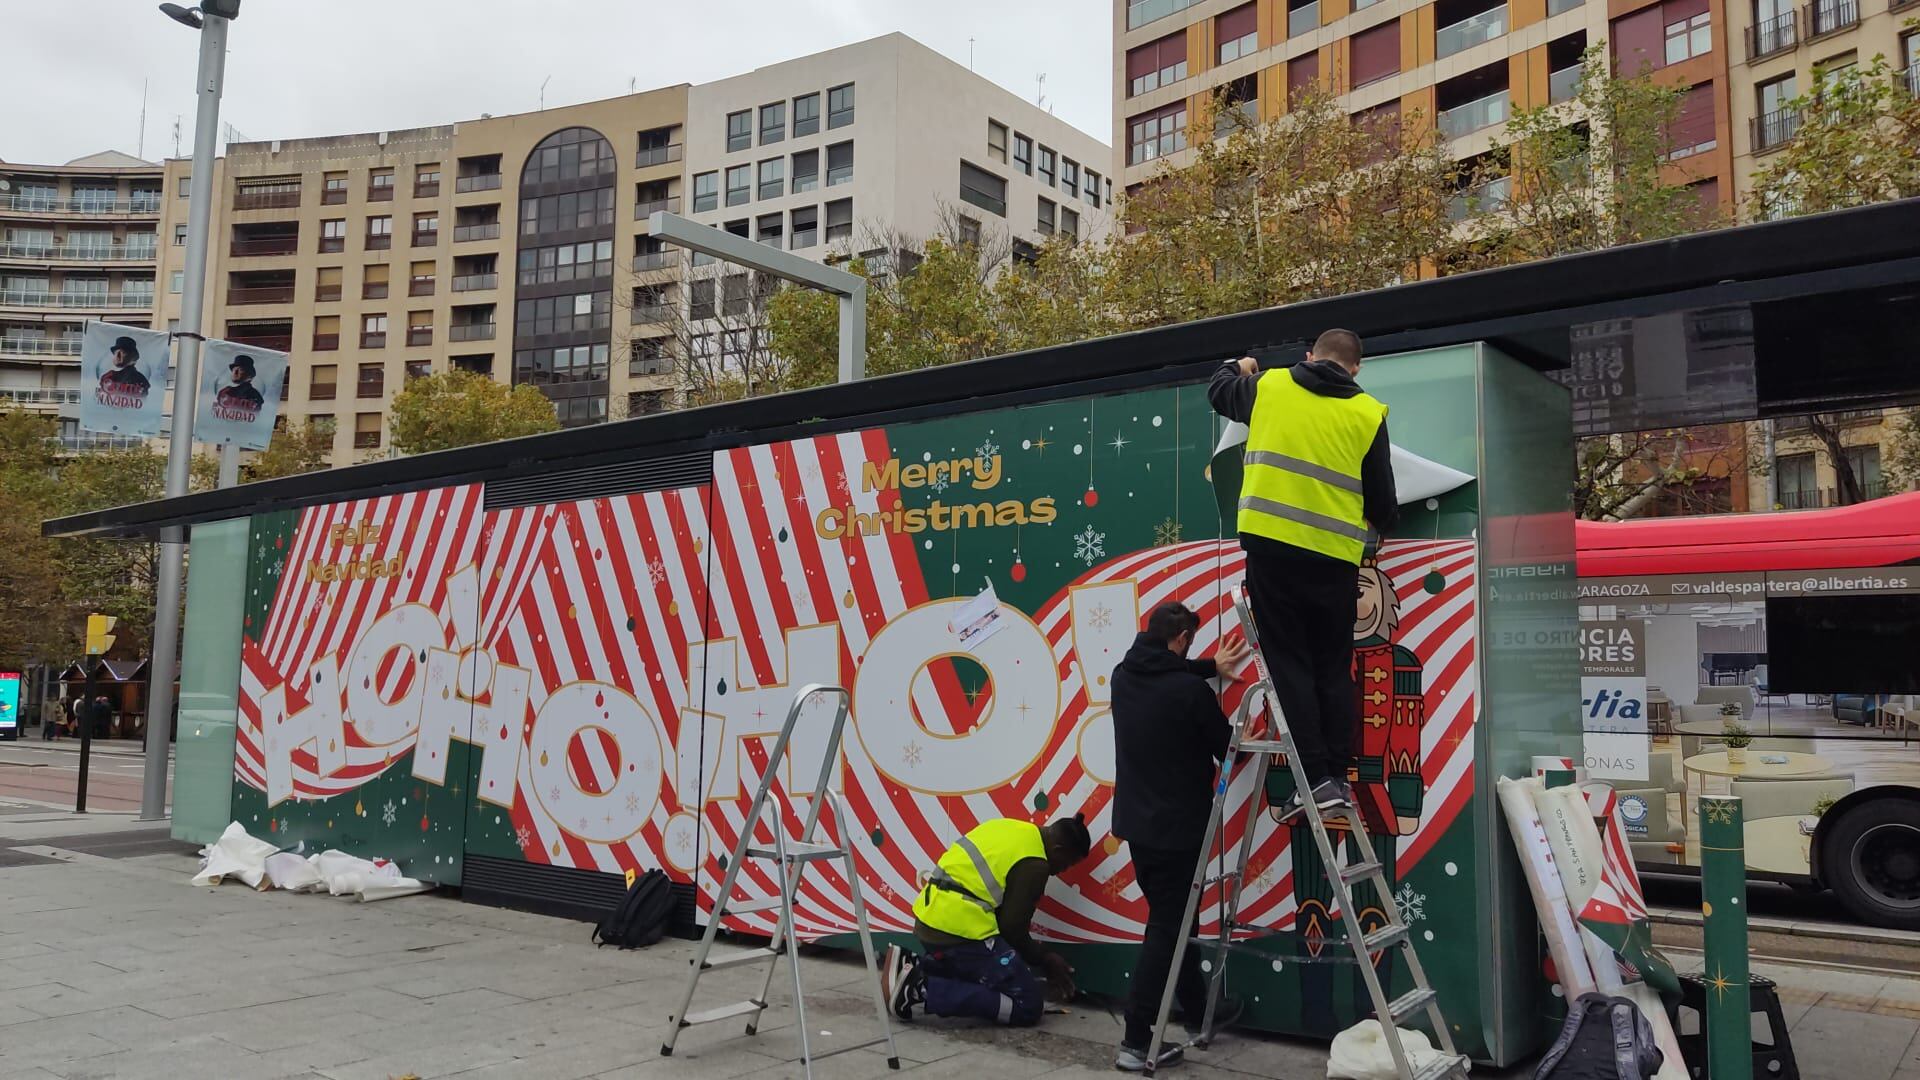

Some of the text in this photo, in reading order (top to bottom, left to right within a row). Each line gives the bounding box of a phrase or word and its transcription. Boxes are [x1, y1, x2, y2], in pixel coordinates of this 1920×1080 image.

[97, 393, 144, 409] NAVIDAD
[213, 406, 256, 423] NAVIDAD
[862, 454, 1002, 493] Merry
[815, 497, 1057, 540] Christmas
[330, 519, 381, 548] Feliz
[306, 550, 404, 583] Navidad
[1578, 584, 1650, 597] ARAGOZA
[1693, 576, 1908, 595] valdespartera@albertia.es
[1583, 689, 1641, 719] tia
